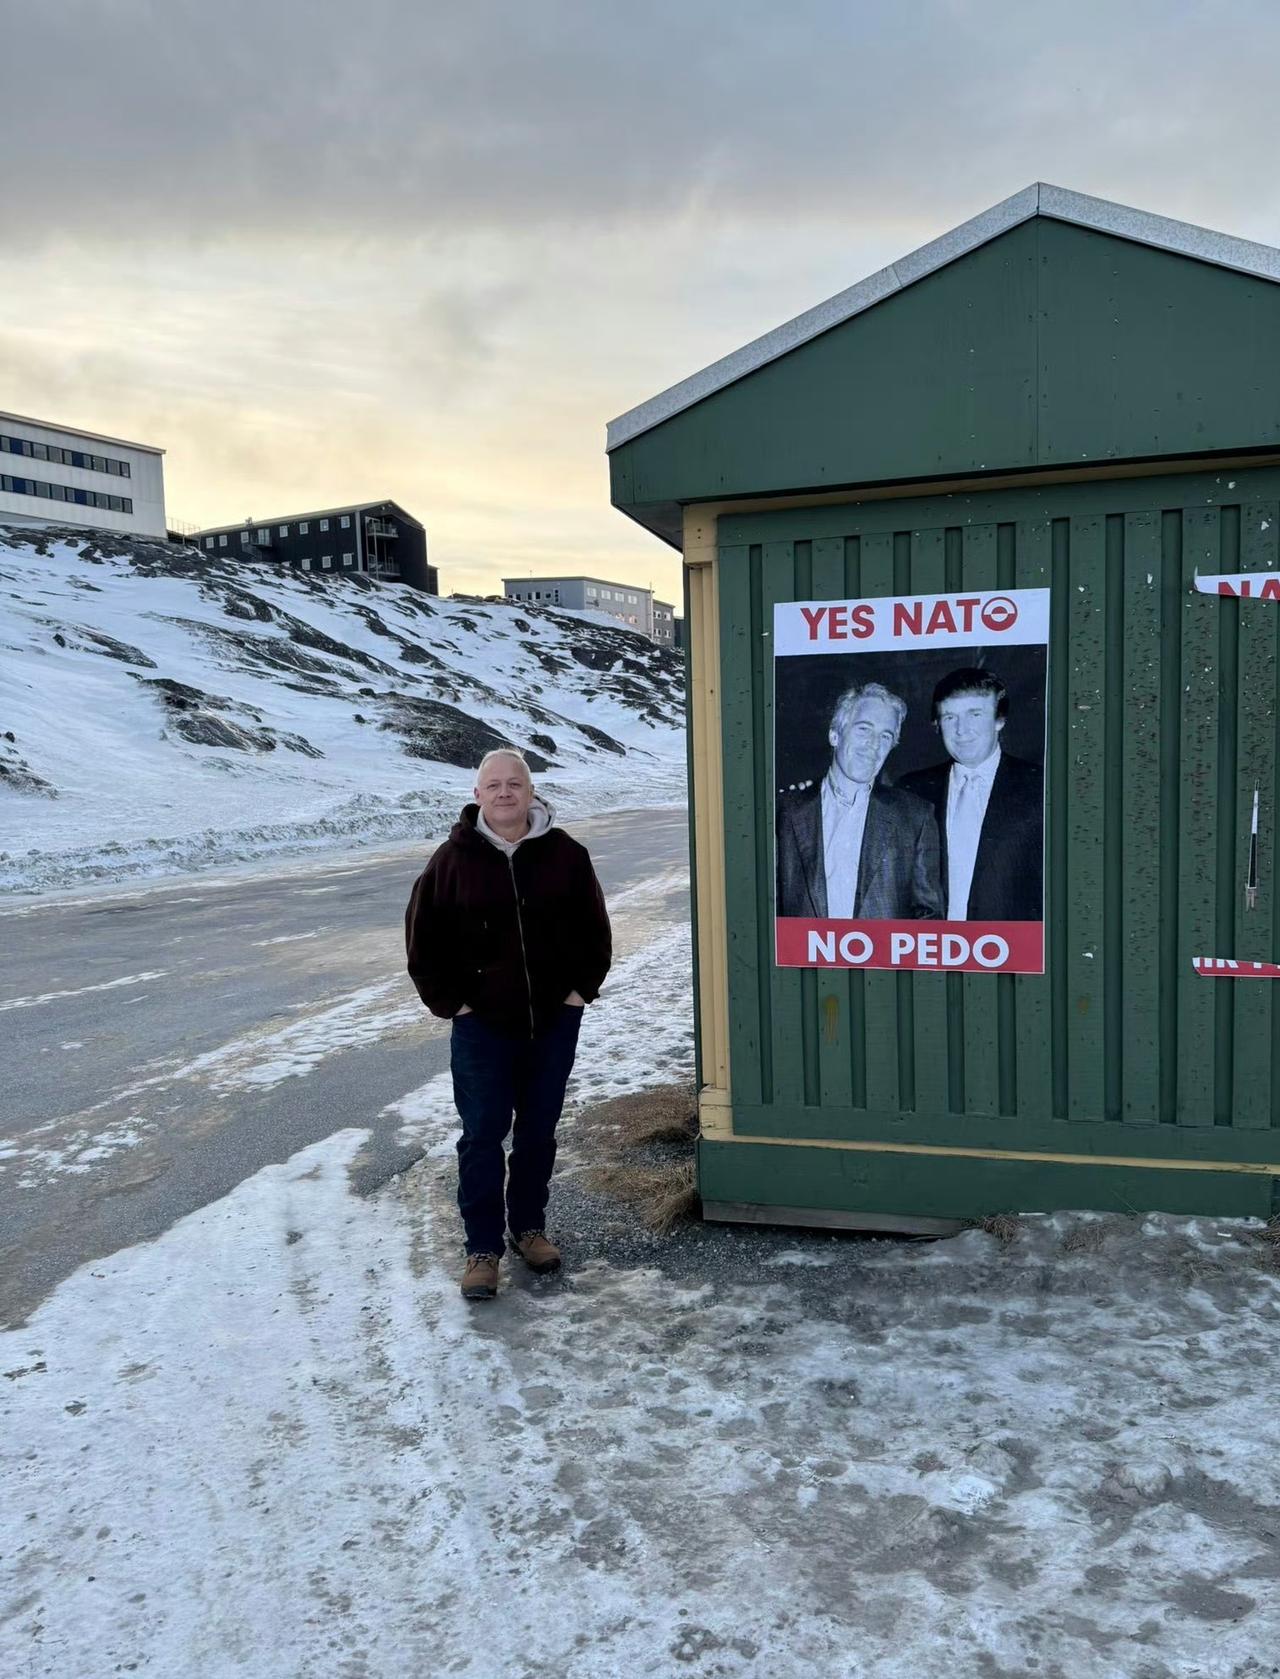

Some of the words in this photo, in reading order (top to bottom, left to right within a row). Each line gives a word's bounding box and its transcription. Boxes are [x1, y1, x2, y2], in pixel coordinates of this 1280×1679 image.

[800, 604, 875, 640] YES
[893, 596, 1018, 636] NATO
[807, 930, 874, 964] NO
[890, 933, 1009, 968] PEDO
